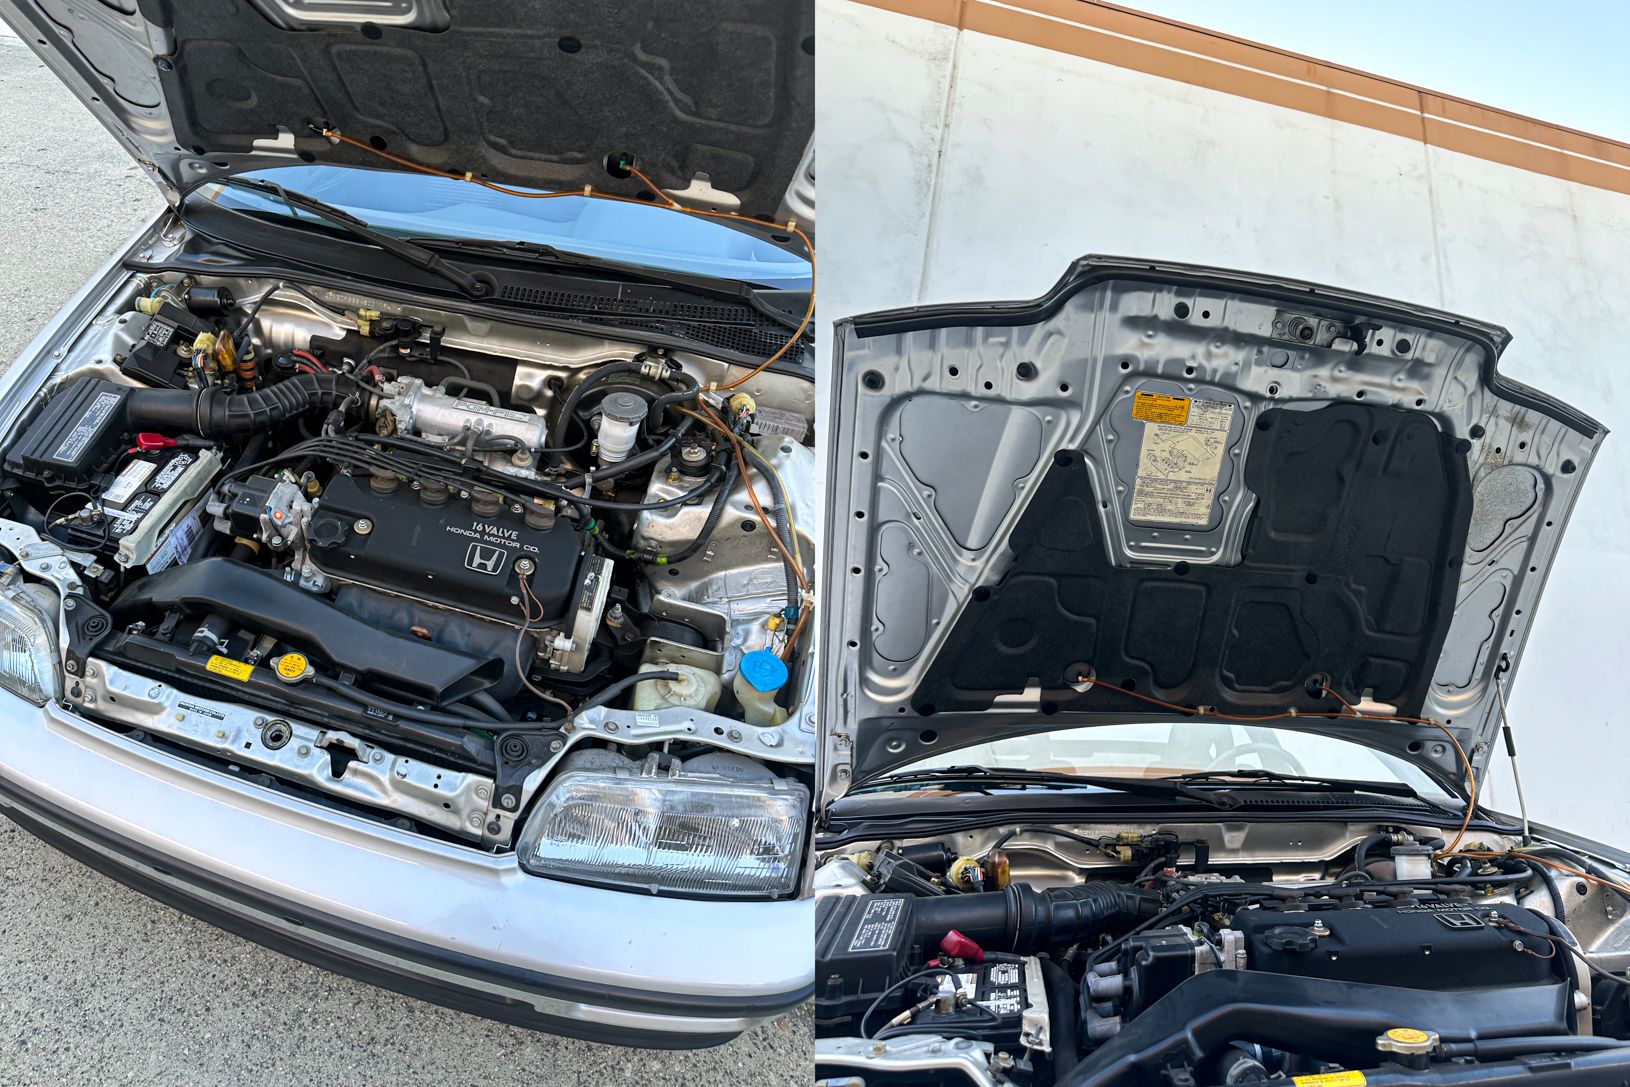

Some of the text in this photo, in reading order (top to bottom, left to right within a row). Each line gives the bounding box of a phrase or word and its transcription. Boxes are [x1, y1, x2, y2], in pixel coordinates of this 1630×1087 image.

[446, 525, 540, 554] HONDA MOTOR CO.
[472, 521, 519, 540] 16 VALVE
